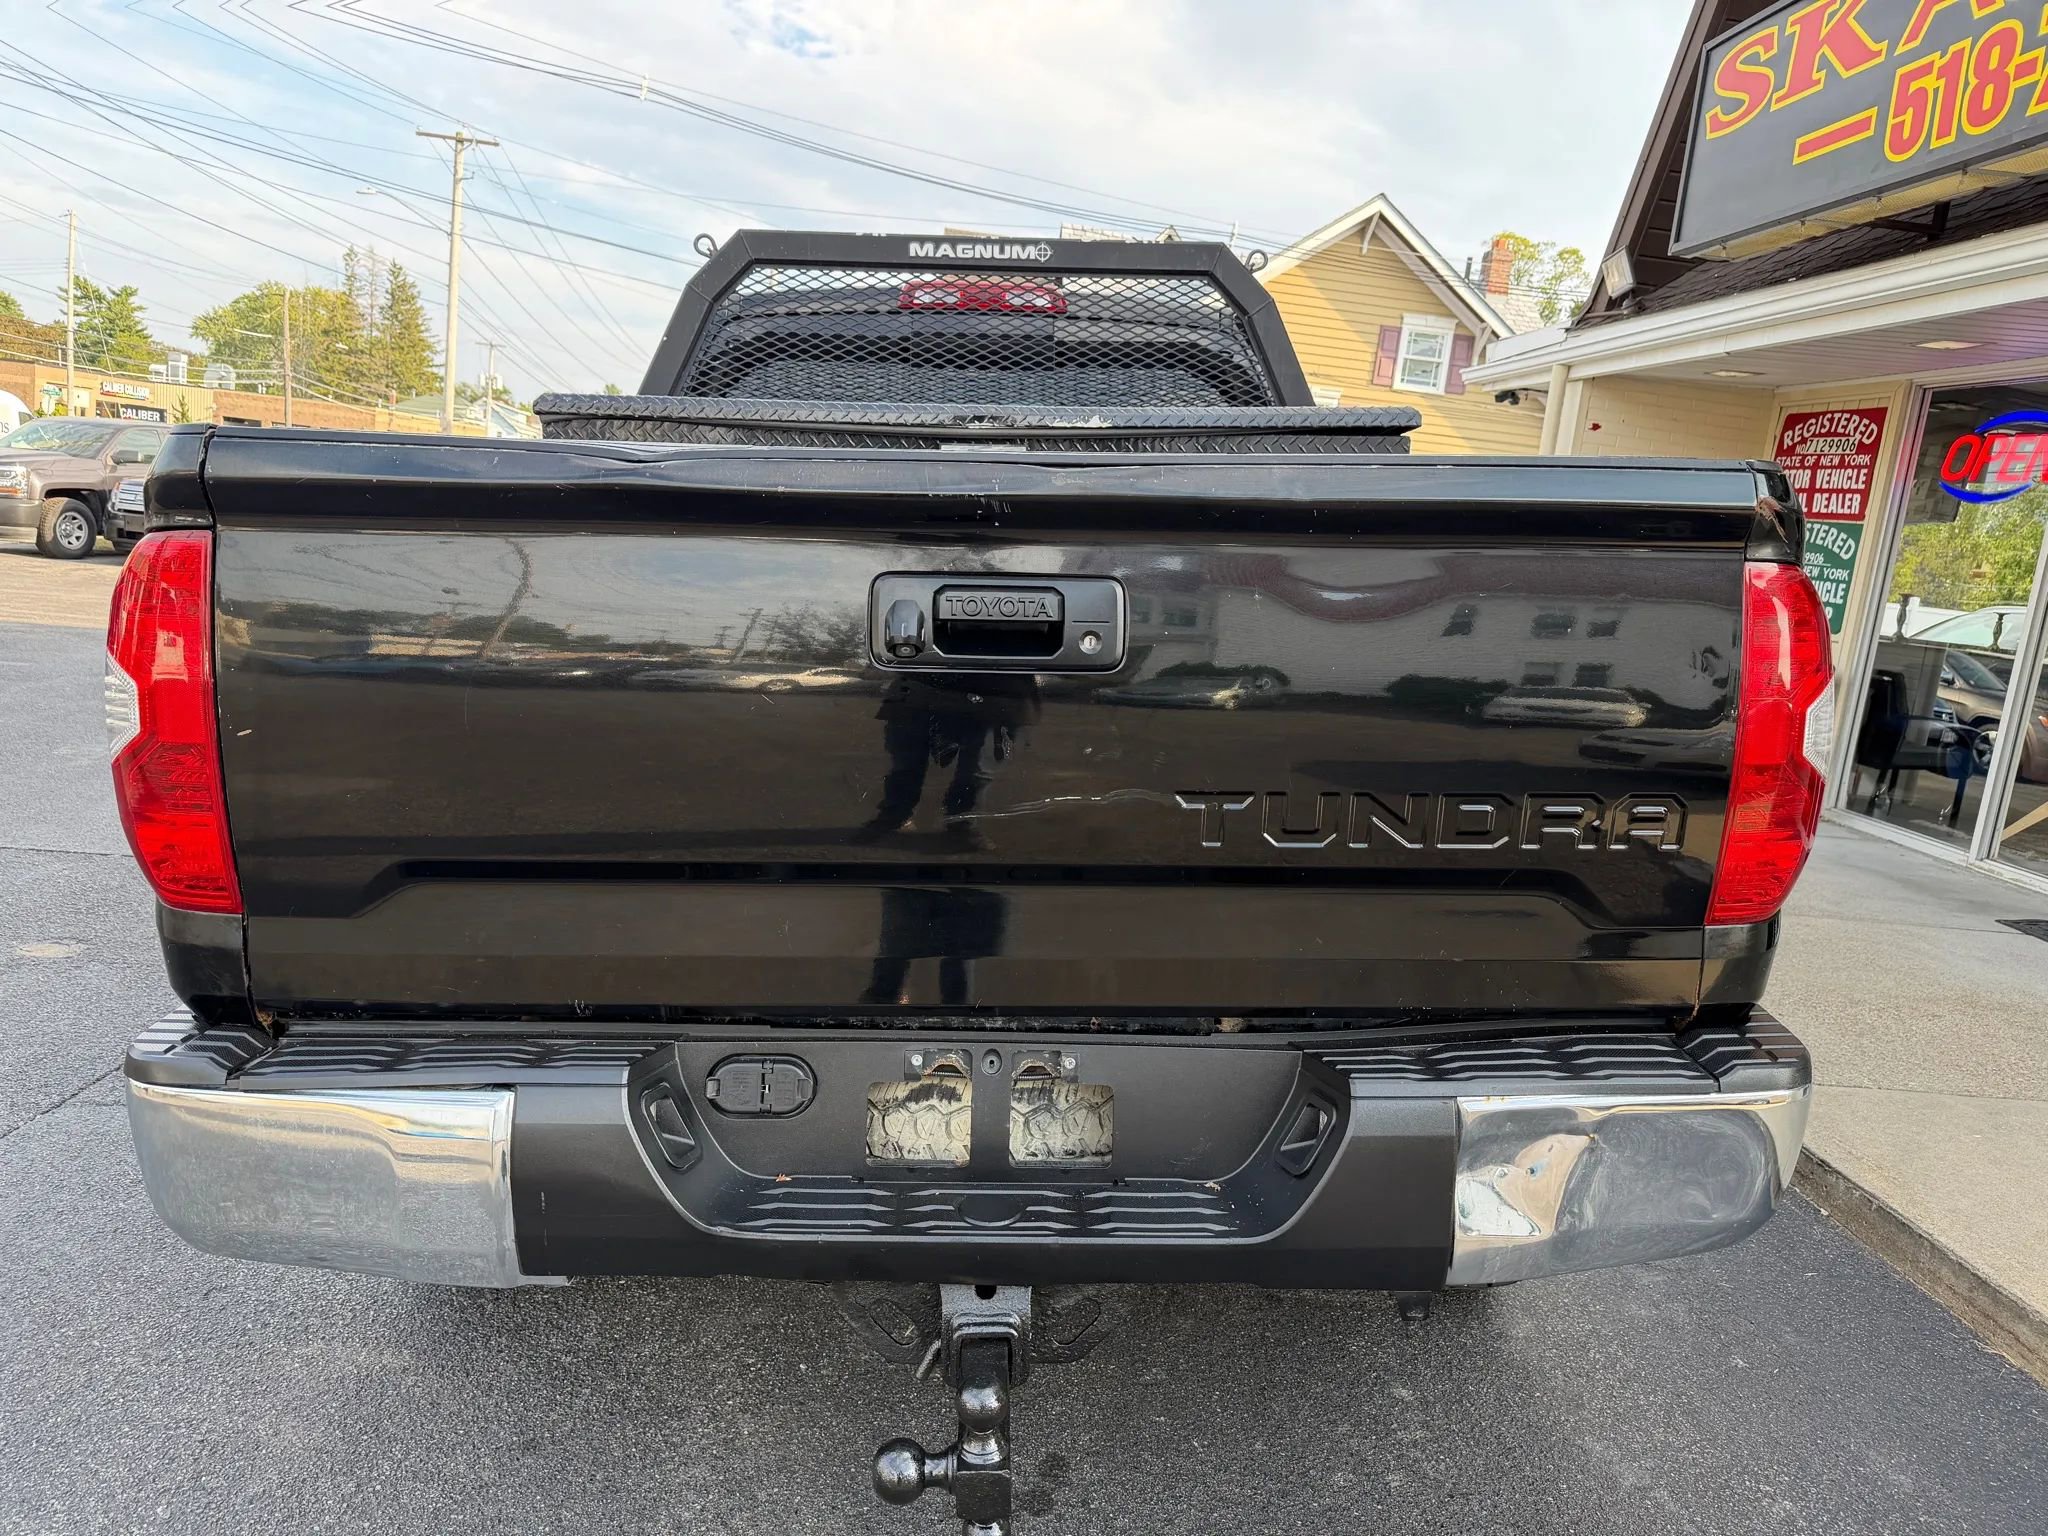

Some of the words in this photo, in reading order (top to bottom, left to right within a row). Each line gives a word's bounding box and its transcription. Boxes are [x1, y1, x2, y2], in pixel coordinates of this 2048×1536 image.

[1884, 18, 2048, 162] 518-
[909, 242, 1036, 260] MAGNUM
[120, 407, 160, 422] CALIBER
[1783, 413, 1878, 450] REGISTERED
[1806, 438, 1857, 453] 7129906
[1776, 456, 1802, 467] STATE
[1804, 456, 1817, 466] OF
[1819, 456, 1840, 466] NEW
[1844, 455, 1872, 466] YORK
[1815, 469, 1868, 489] VEHICLE
[1812, 493, 1861, 514] DEALER
[1805, 523, 1856, 560] STERED
[1805, 552, 1824, 565] 9906
[1823, 568, 1850, 581] YORK
[946, 596, 1053, 618] TOYOTA
[1174, 790, 1688, 851] TUNDRA
